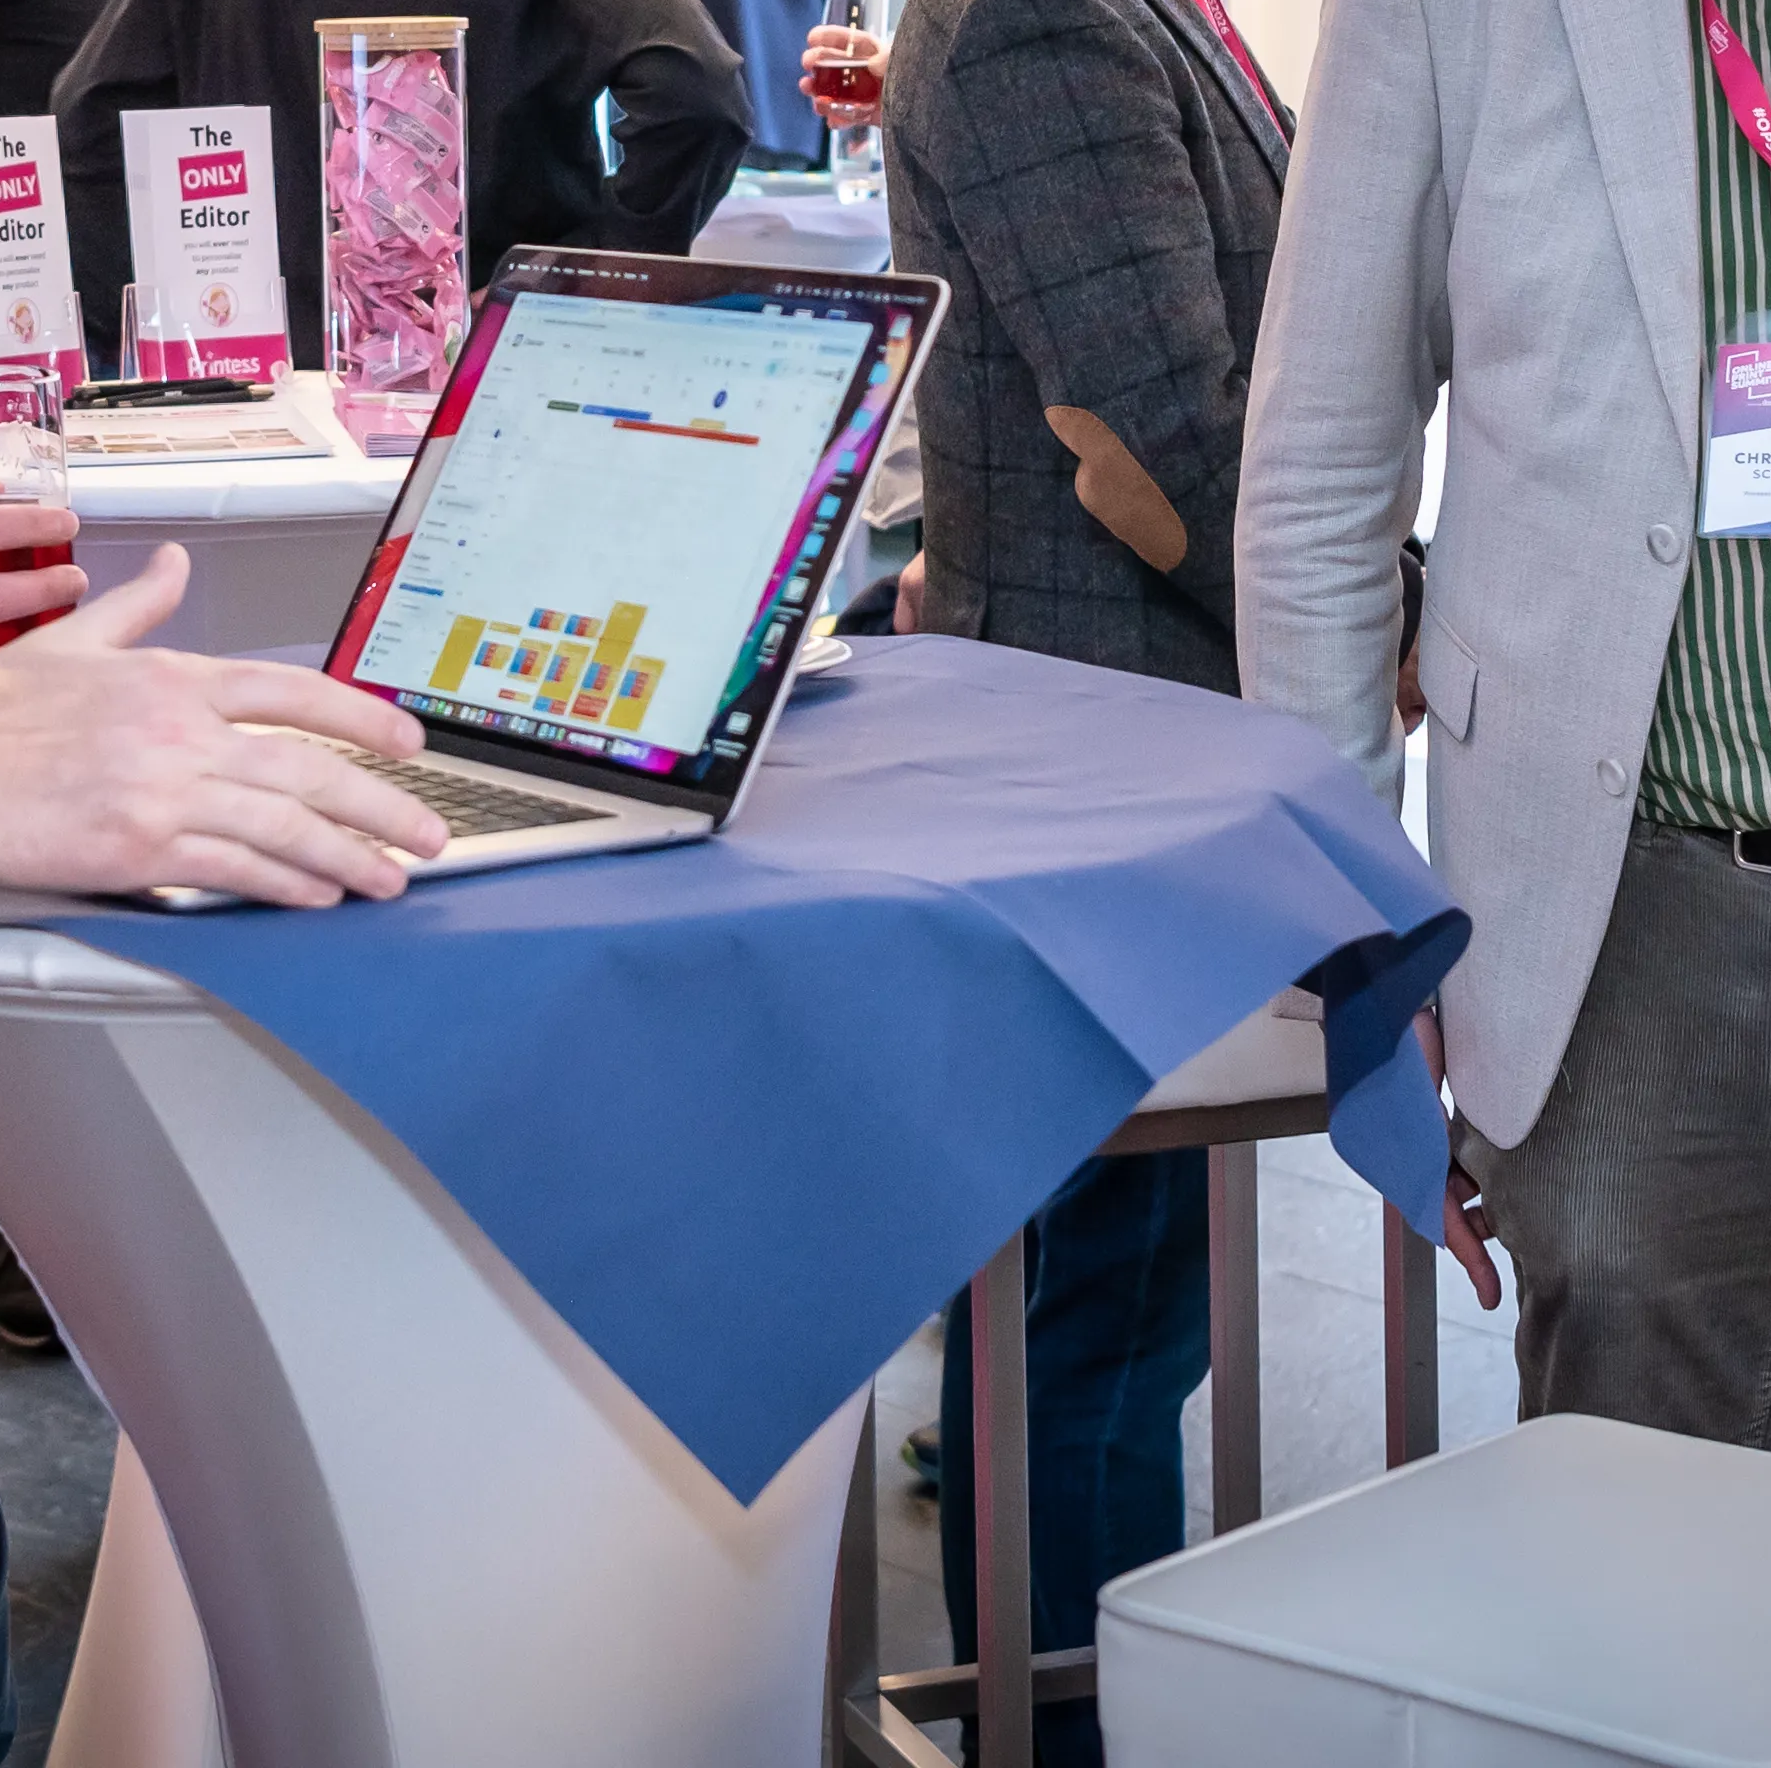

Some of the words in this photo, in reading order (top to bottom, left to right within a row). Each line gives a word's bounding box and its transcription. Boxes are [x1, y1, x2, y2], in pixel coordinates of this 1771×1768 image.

[189, 124, 233, 147] The
[183, 163, 243, 191] ONLY
[180, 205, 250, 229] Editor
